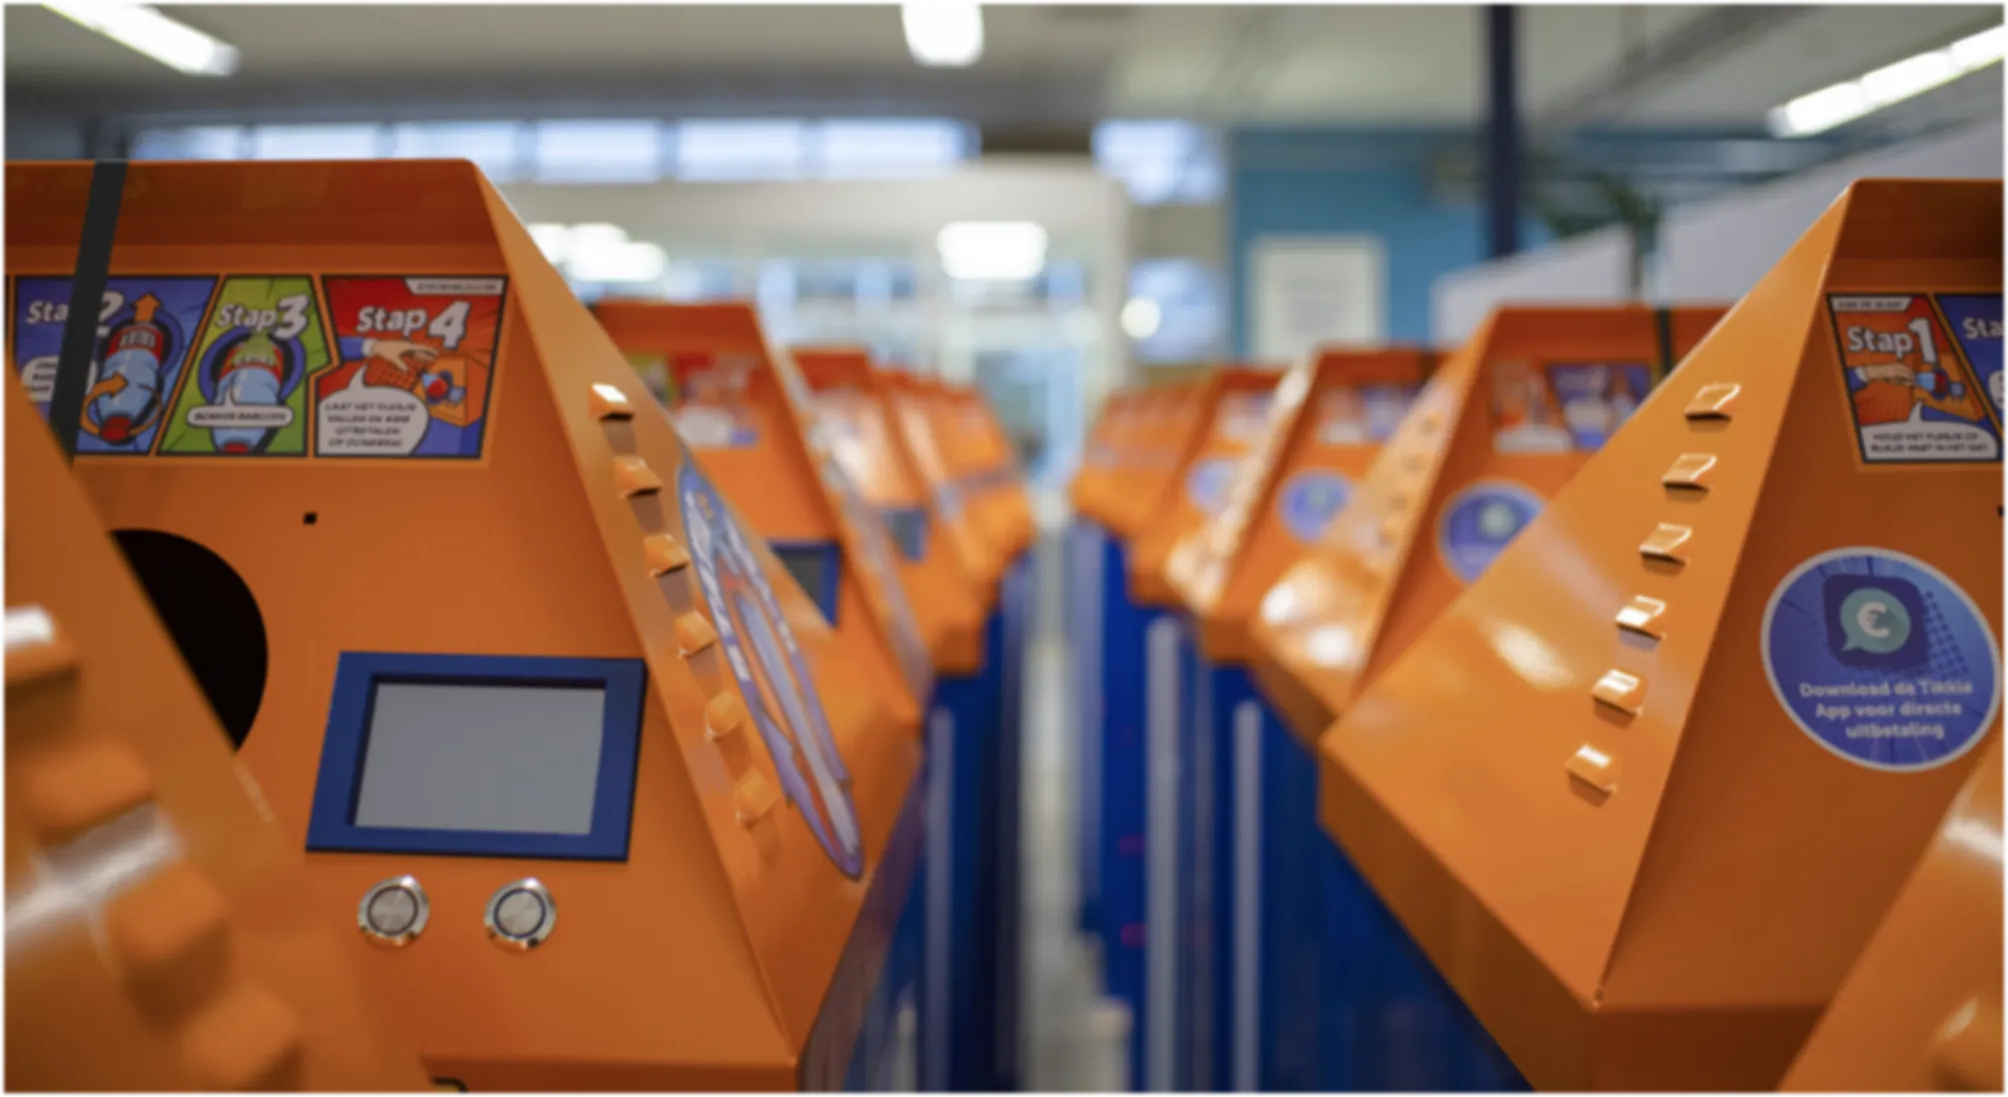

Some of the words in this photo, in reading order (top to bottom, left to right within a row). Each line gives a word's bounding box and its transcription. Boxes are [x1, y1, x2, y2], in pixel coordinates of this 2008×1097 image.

[26, 300, 69, 324] Sta
[216, 303, 277, 333] Stap
[275, 293, 310, 340] 3
[356, 305, 428, 340] Stap
[428, 300, 472, 349] 4
[1962, 316, 2007, 340] Sta
[1846, 325, 1914, 360] Stap
[1908, 317, 1938, 364] 1
[1799, 681, 1890, 698] Download
[1893, 680, 1916, 697] de
[1917, 678, 1974, 696] Tikkie
[1815, 703, 1851, 721] App
[1854, 704, 1895, 717] voor
[1899, 700, 1963, 717] directe
[1845, 722, 1945, 740] uitbetaling
